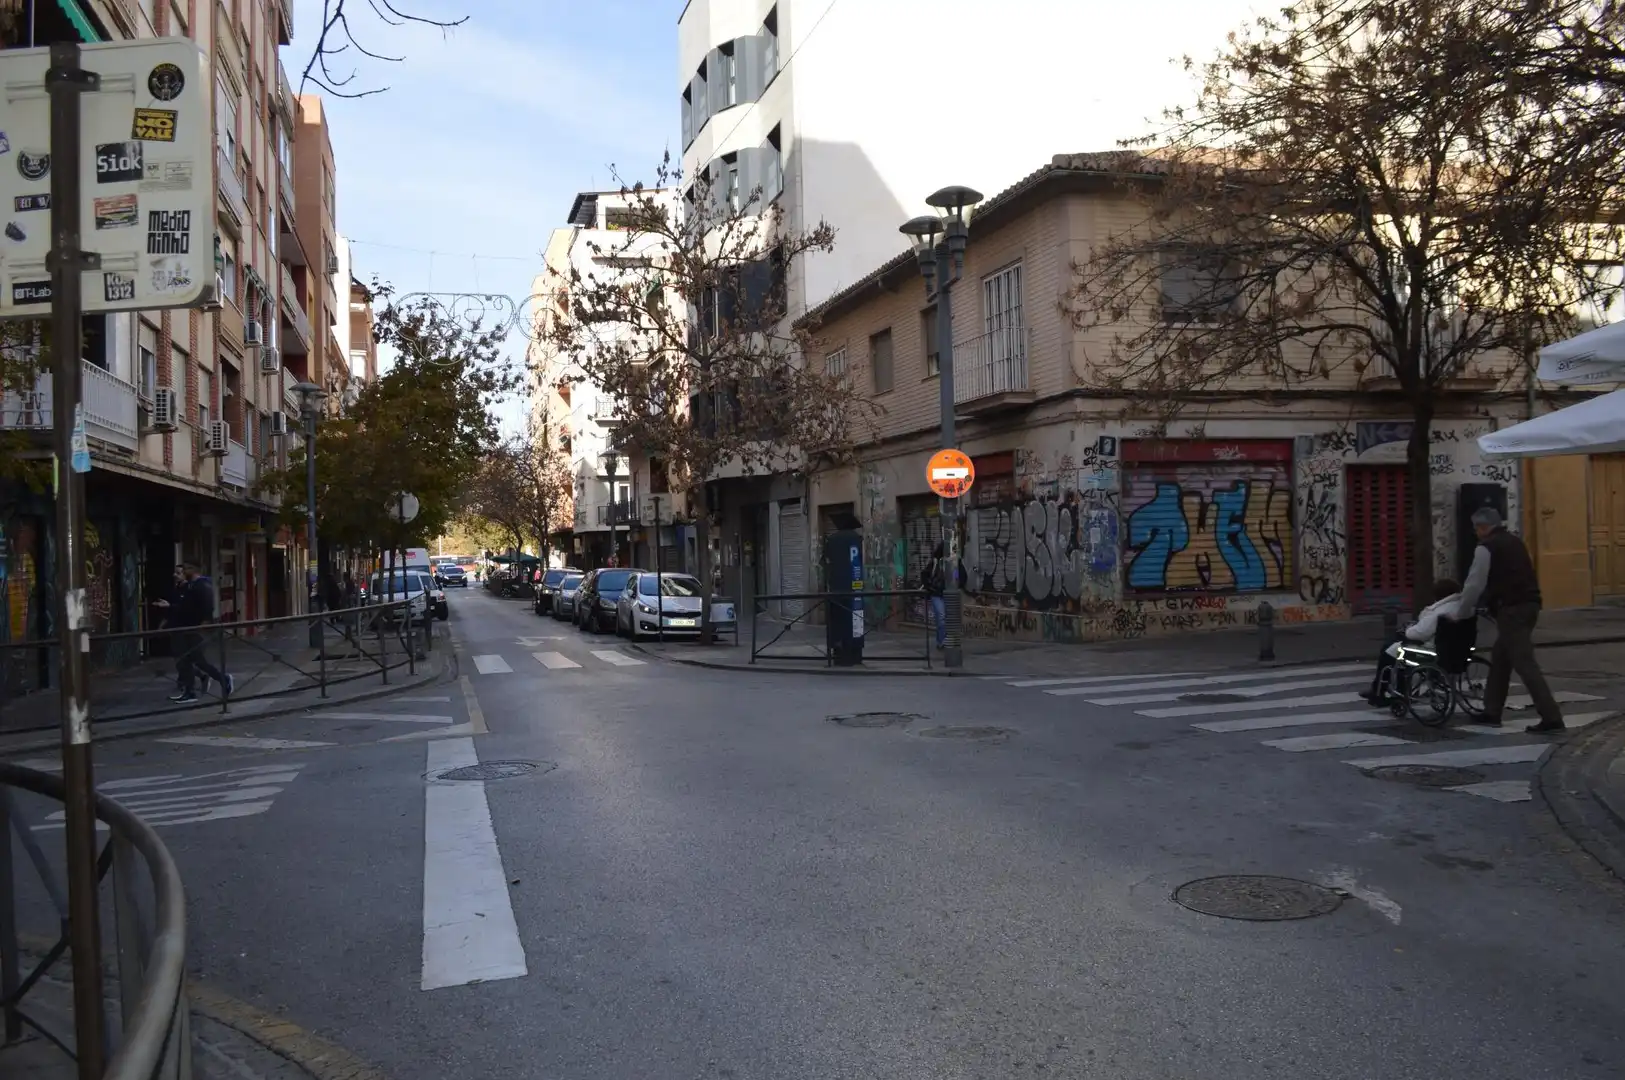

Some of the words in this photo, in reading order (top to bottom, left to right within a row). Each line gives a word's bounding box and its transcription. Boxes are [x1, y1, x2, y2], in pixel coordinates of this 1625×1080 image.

[137, 117, 173, 129] NO
[135, 127, 173, 139] VALE
[850, 546, 859, 563] P
